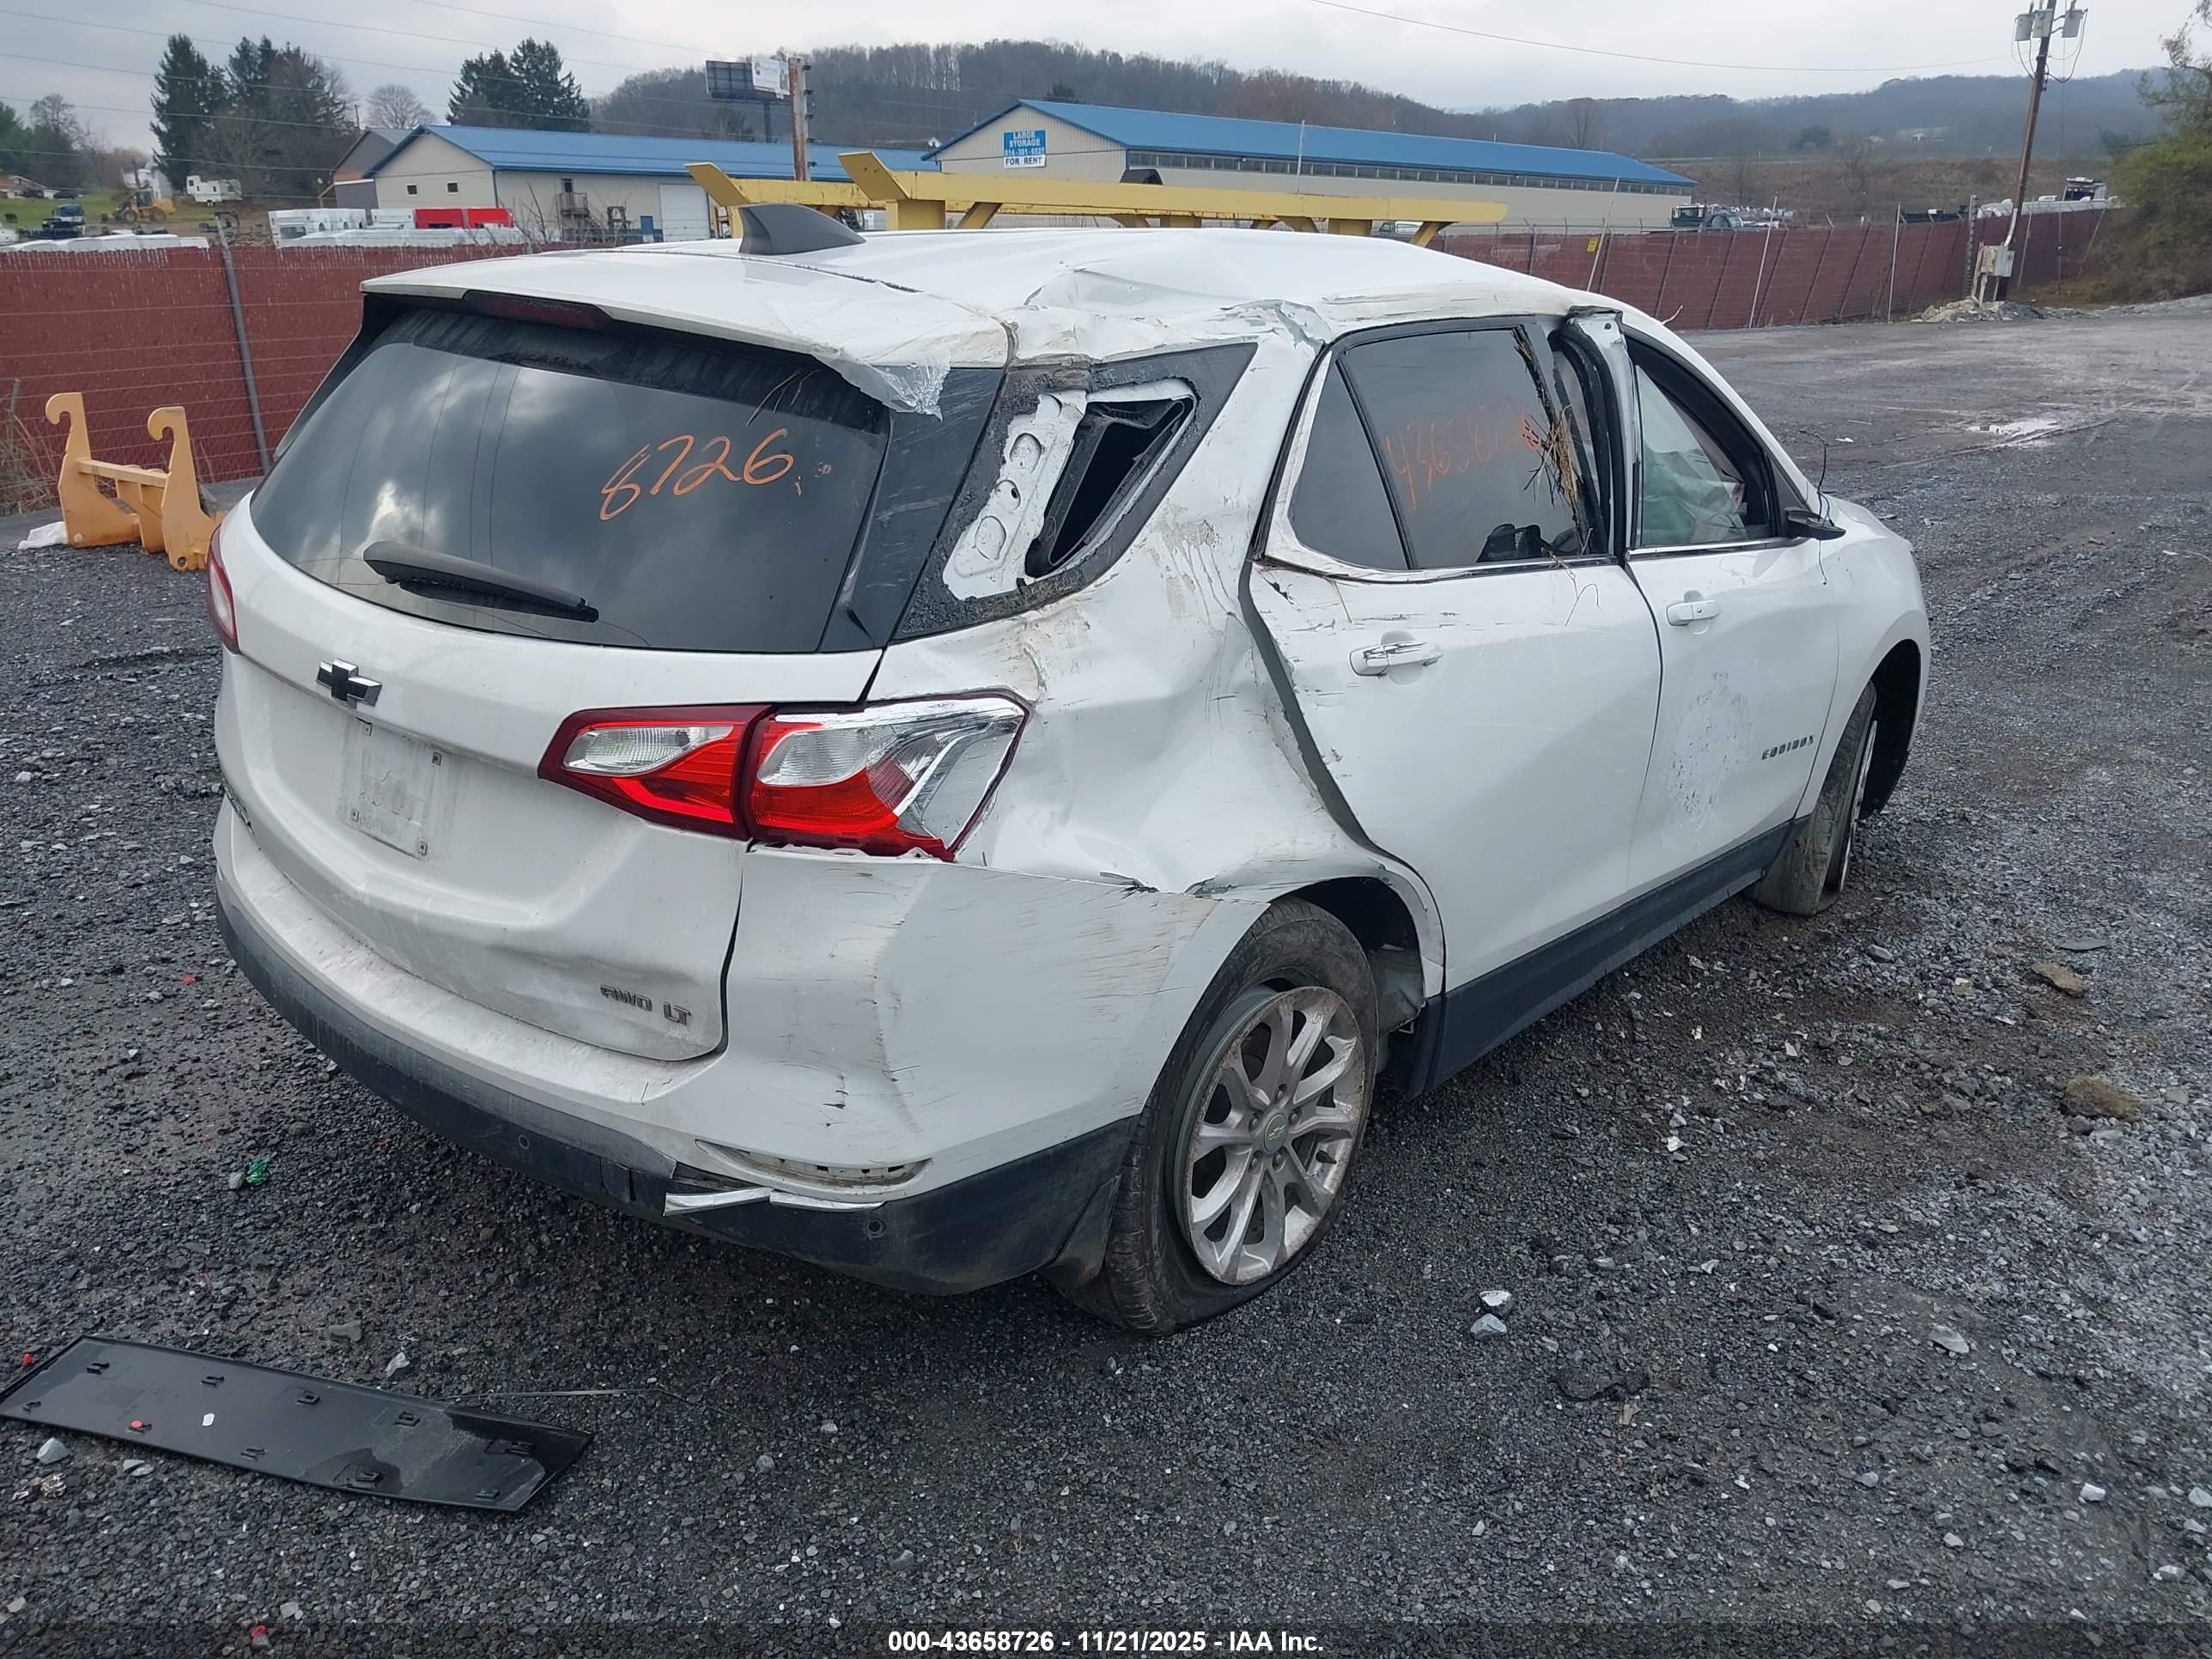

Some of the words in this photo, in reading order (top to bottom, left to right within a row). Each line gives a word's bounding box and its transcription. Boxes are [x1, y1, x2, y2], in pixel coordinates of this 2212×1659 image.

[1013, 131, 1036, 139] LARGE
[1009, 138, 1041, 148] STORAGE
[1006, 157, 1020, 166] FOR
[1024, 156, 1042, 165] RENT
[1761, 735, 1814, 761] EQUINOX
[600, 984, 653, 1012] AWD
[663, 1001, 692, 1026] LT
